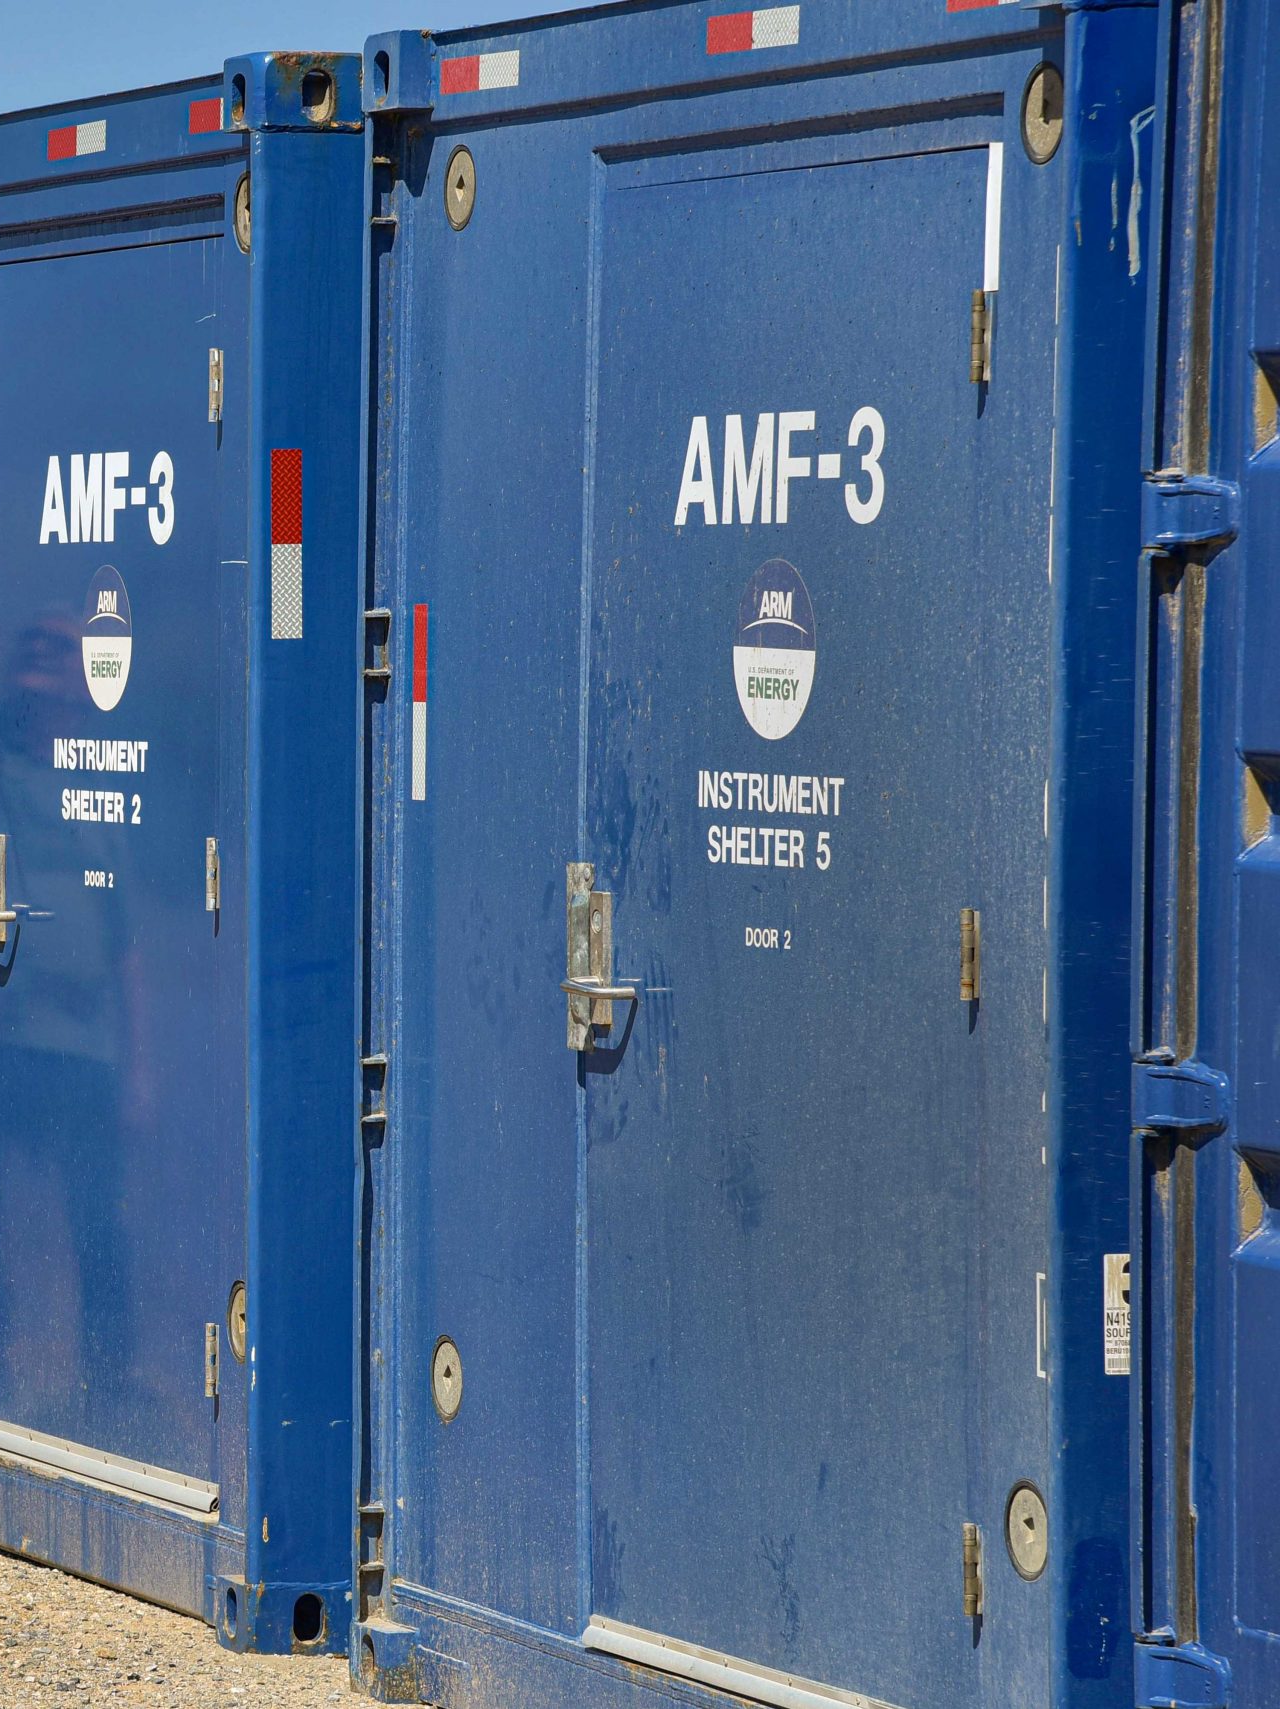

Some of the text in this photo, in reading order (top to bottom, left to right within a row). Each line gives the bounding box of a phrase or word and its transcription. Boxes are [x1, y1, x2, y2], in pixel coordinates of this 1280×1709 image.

[674, 406, 886, 526] AMF-3
[39, 450, 174, 546] AMF-3
[97, 590, 117, 612] ARM
[759, 591, 792, 620] ARM
[91, 660, 122, 678] ENERGY
[748, 666, 756, 674] U.S.
[757, 667, 787, 675] DEPARTMENT
[747, 676, 800, 702] ENERGY
[53, 737, 148, 773] INSTRUMENT
[61, 788, 141, 824] SHELTER 2
[698, 770, 845, 816] INSTRUMENT
[707, 825, 831, 871] SHELTER 5
[84, 870, 113, 888] DOOR 2
[745, 927, 791, 950] DOOR 2
